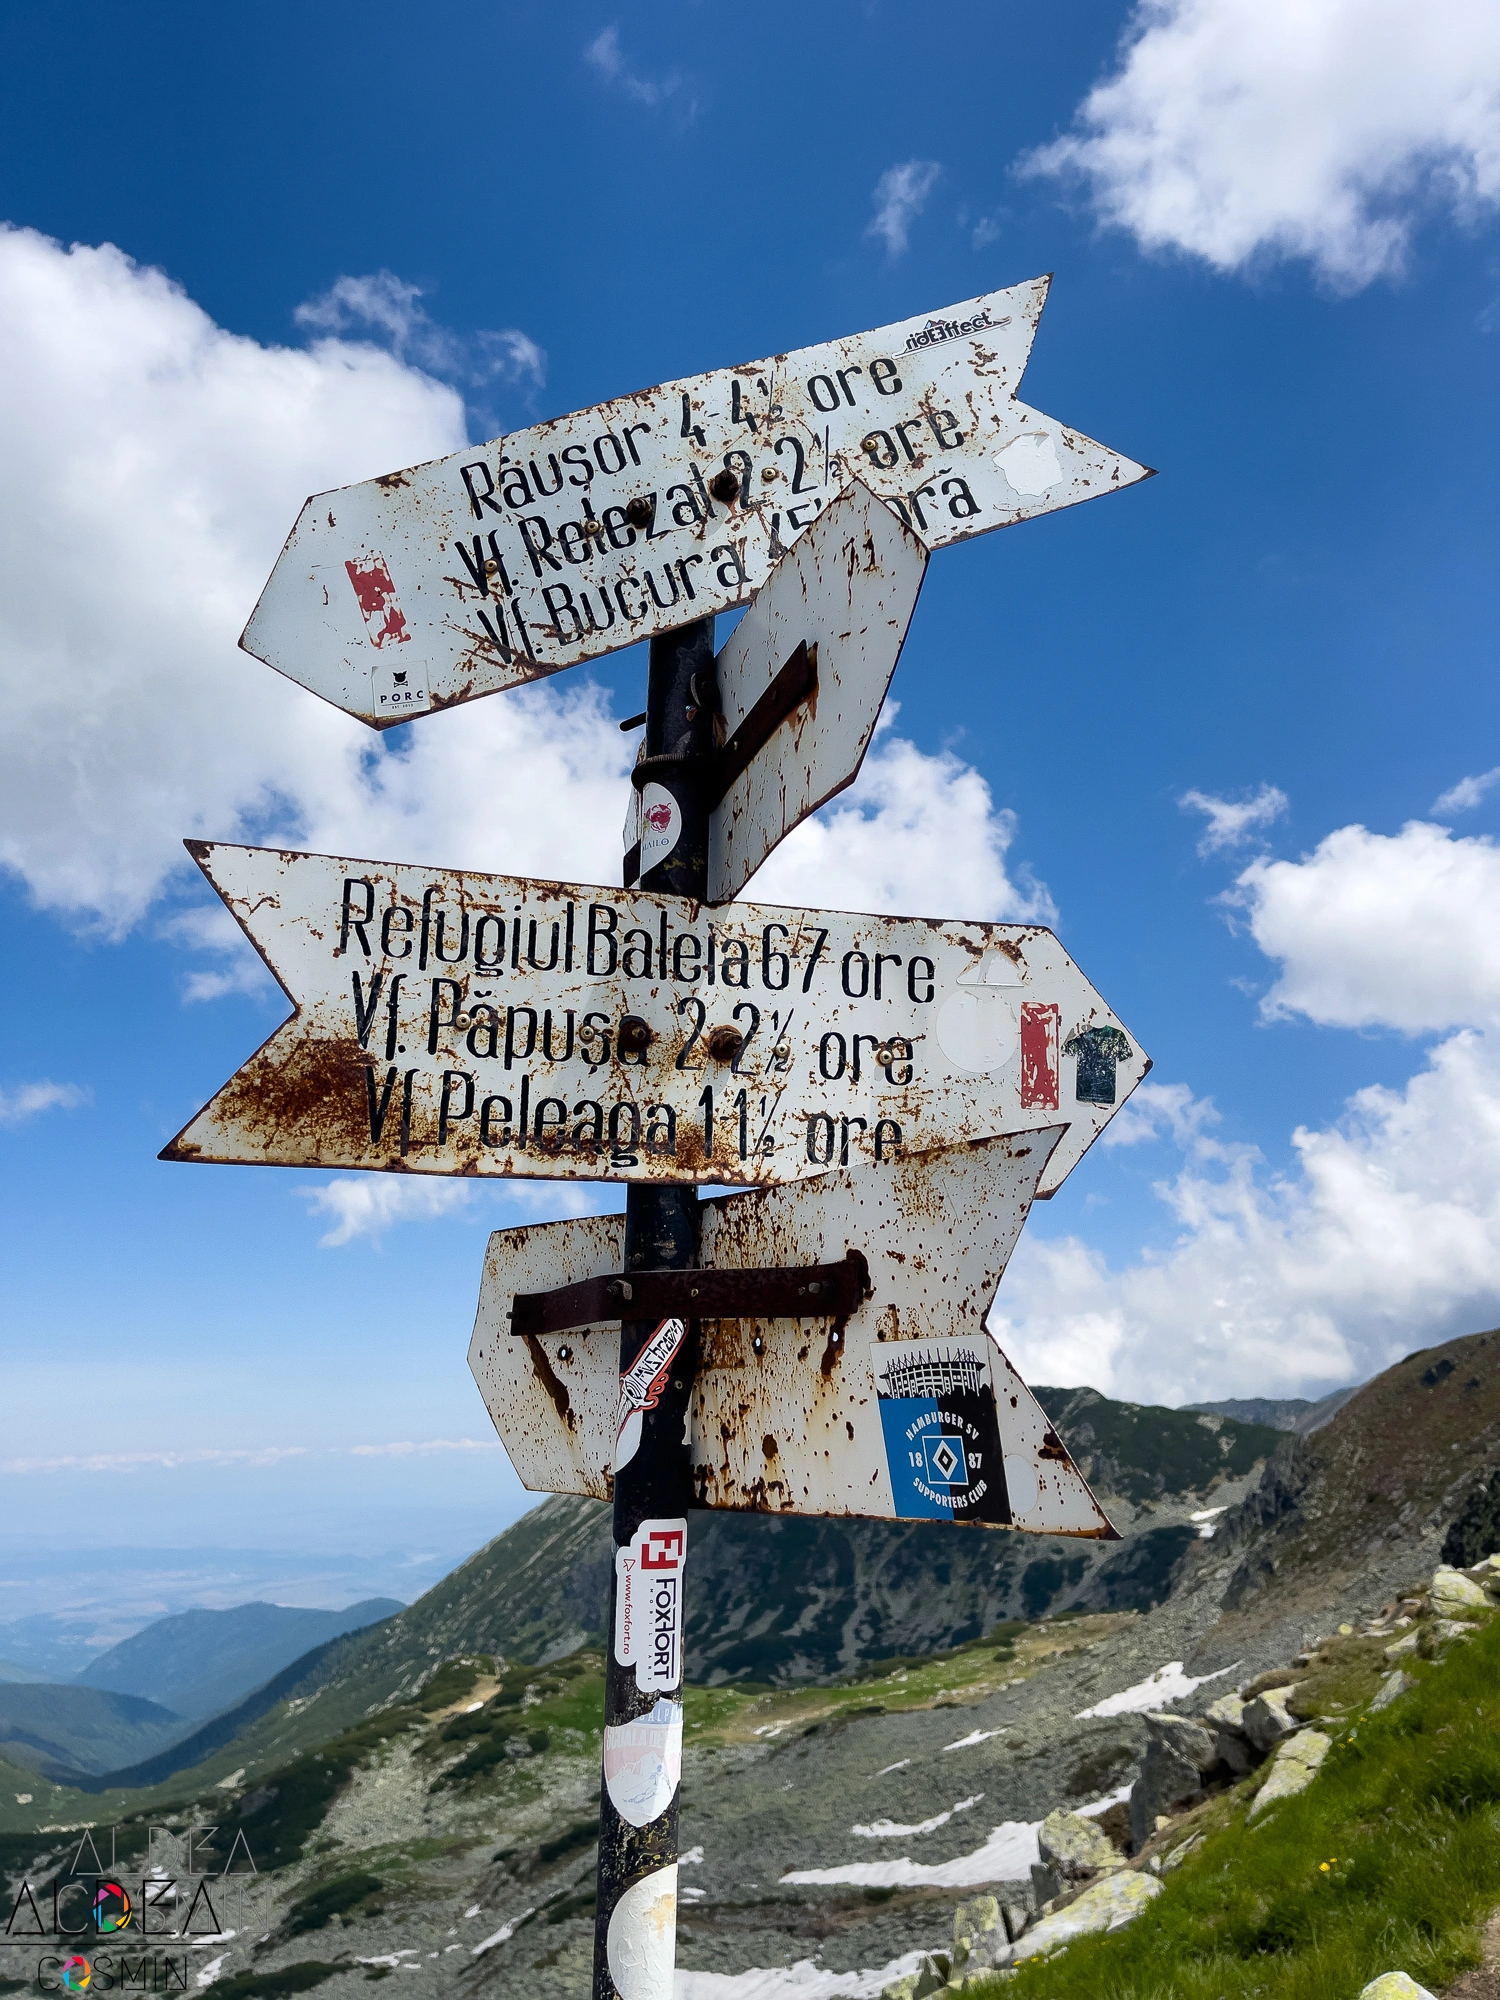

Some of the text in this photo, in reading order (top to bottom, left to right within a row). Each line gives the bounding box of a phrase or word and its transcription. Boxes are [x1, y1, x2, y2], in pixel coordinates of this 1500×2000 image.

[807, 358, 903, 412] ore
[862, 410, 965, 470] ore
[541, 543, 753, 647] Bucura
[381, 690, 424, 704] PORC
[339, 877, 574, 977] Refugiul
[588, 902, 754, 991] Baleia
[842, 950, 935, 1005] ore
[819, 1031, 914, 1086] ore
[439, 1069, 678, 1169] Peleaga
[806, 1113, 904, 1167] ore
[905, 1411, 980, 1442] HAMBURGER SV
[908, 1451, 983, 1469] 18 87
[912, 1477, 988, 1509] SUPPORTERS CLUB
[623, 1574, 633, 1655] www.foxfort.ro
